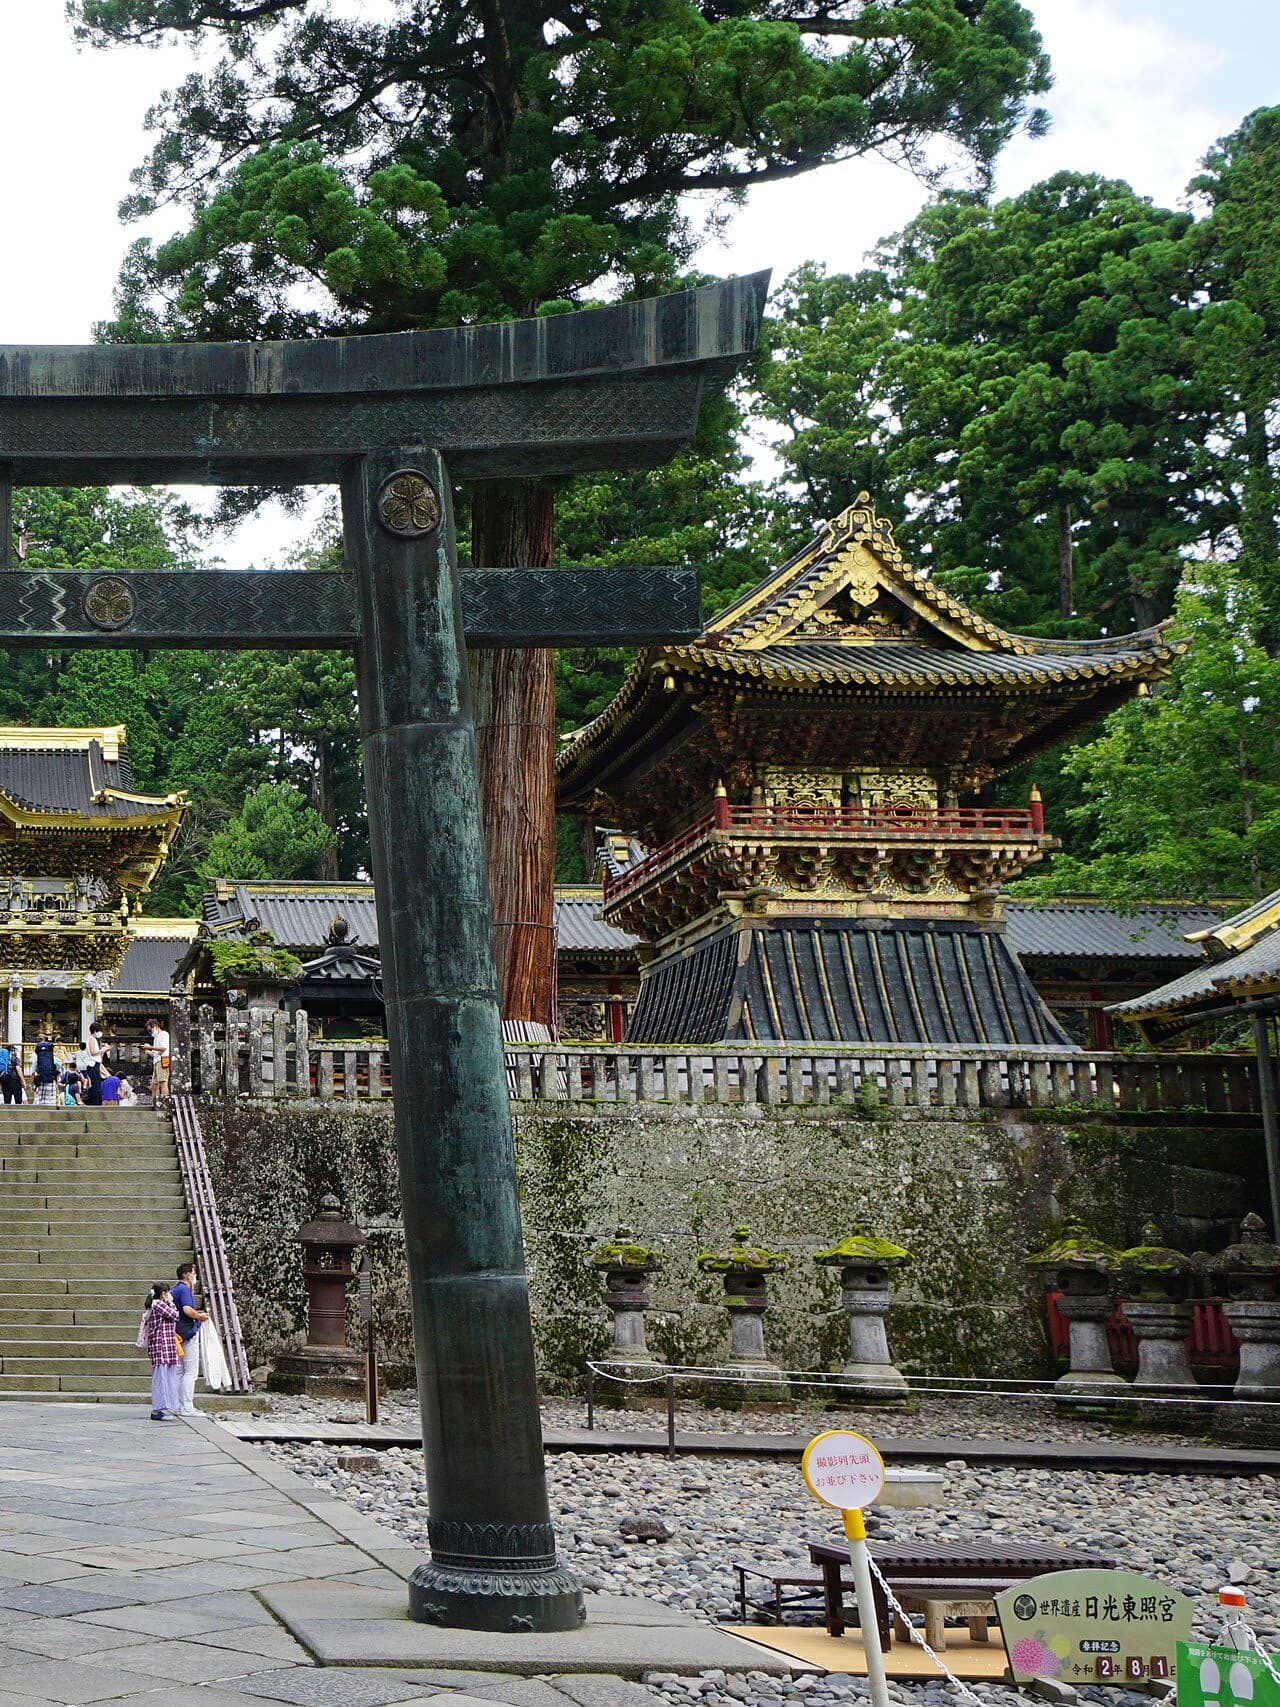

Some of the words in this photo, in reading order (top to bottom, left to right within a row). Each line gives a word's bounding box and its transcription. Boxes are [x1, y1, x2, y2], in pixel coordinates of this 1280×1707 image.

[816, 1472, 879, 1487] お並び下さい
[1039, 1599, 1081, 1617] 世界遺産
[1085, 1594, 1177, 1622] 日光東照宮
